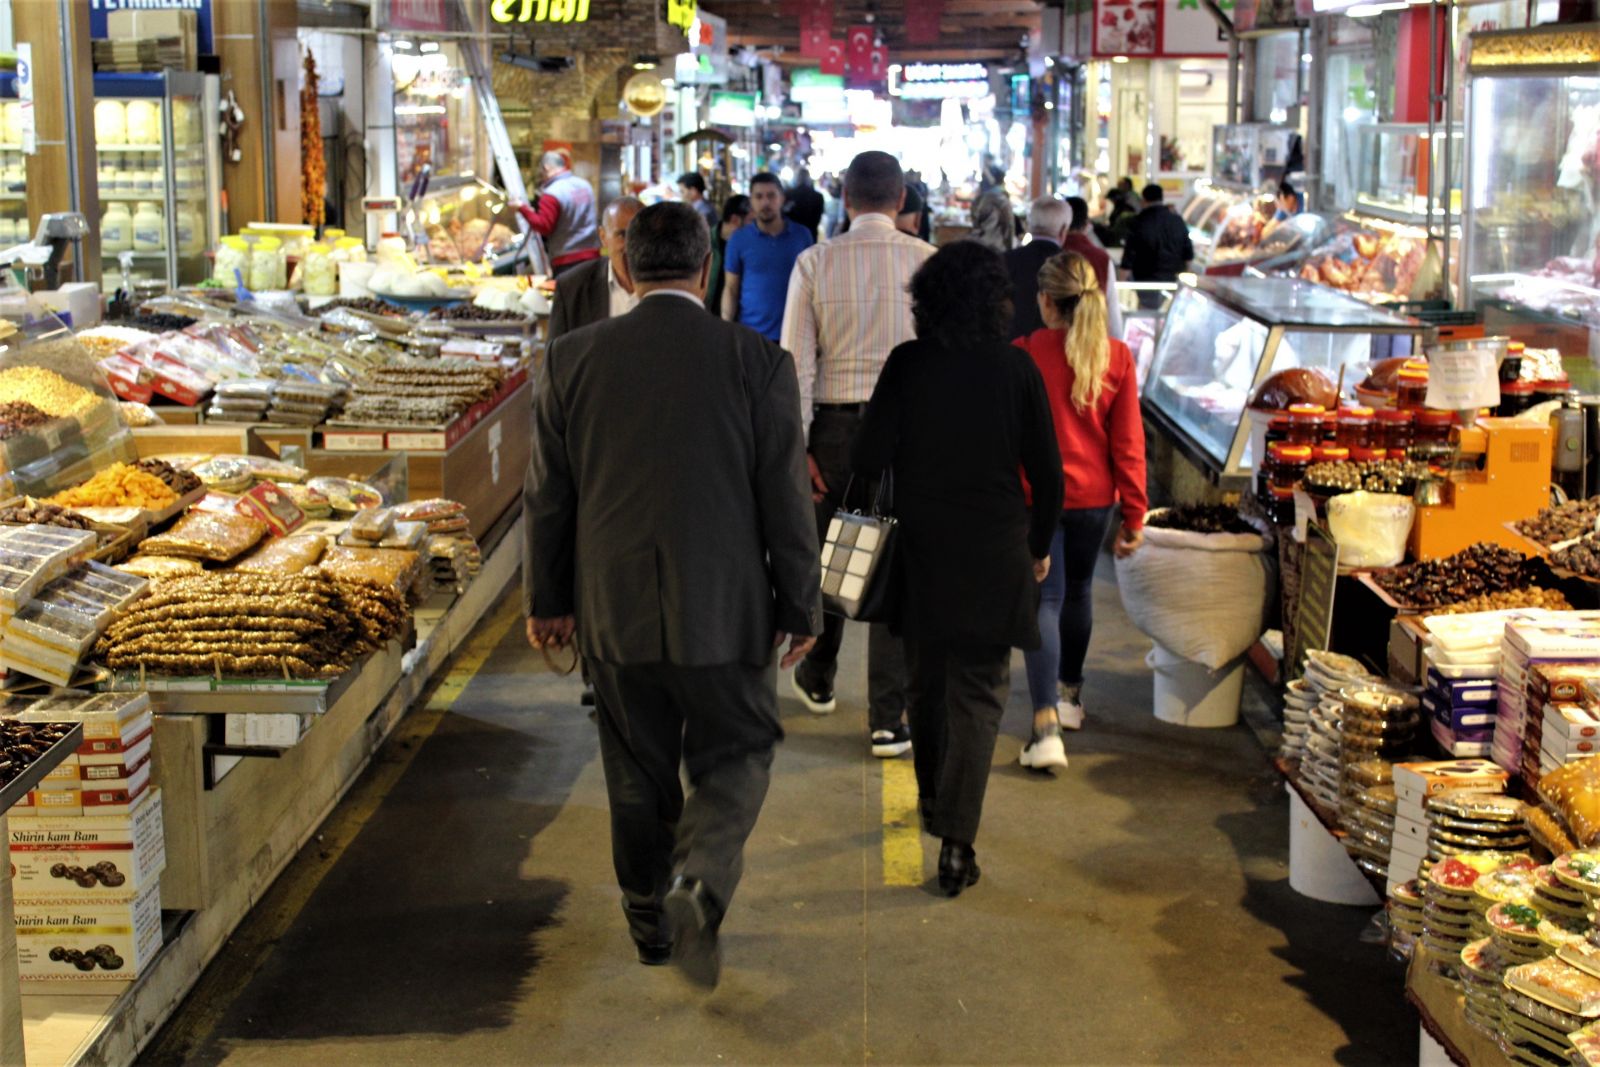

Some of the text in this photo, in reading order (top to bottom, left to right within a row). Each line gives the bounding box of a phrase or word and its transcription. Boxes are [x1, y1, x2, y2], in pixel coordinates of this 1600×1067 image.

[12, 831, 98, 842] Shirin kam Bam
[46, 915, 69, 925] kam
[72, 915, 97, 925] Bam
